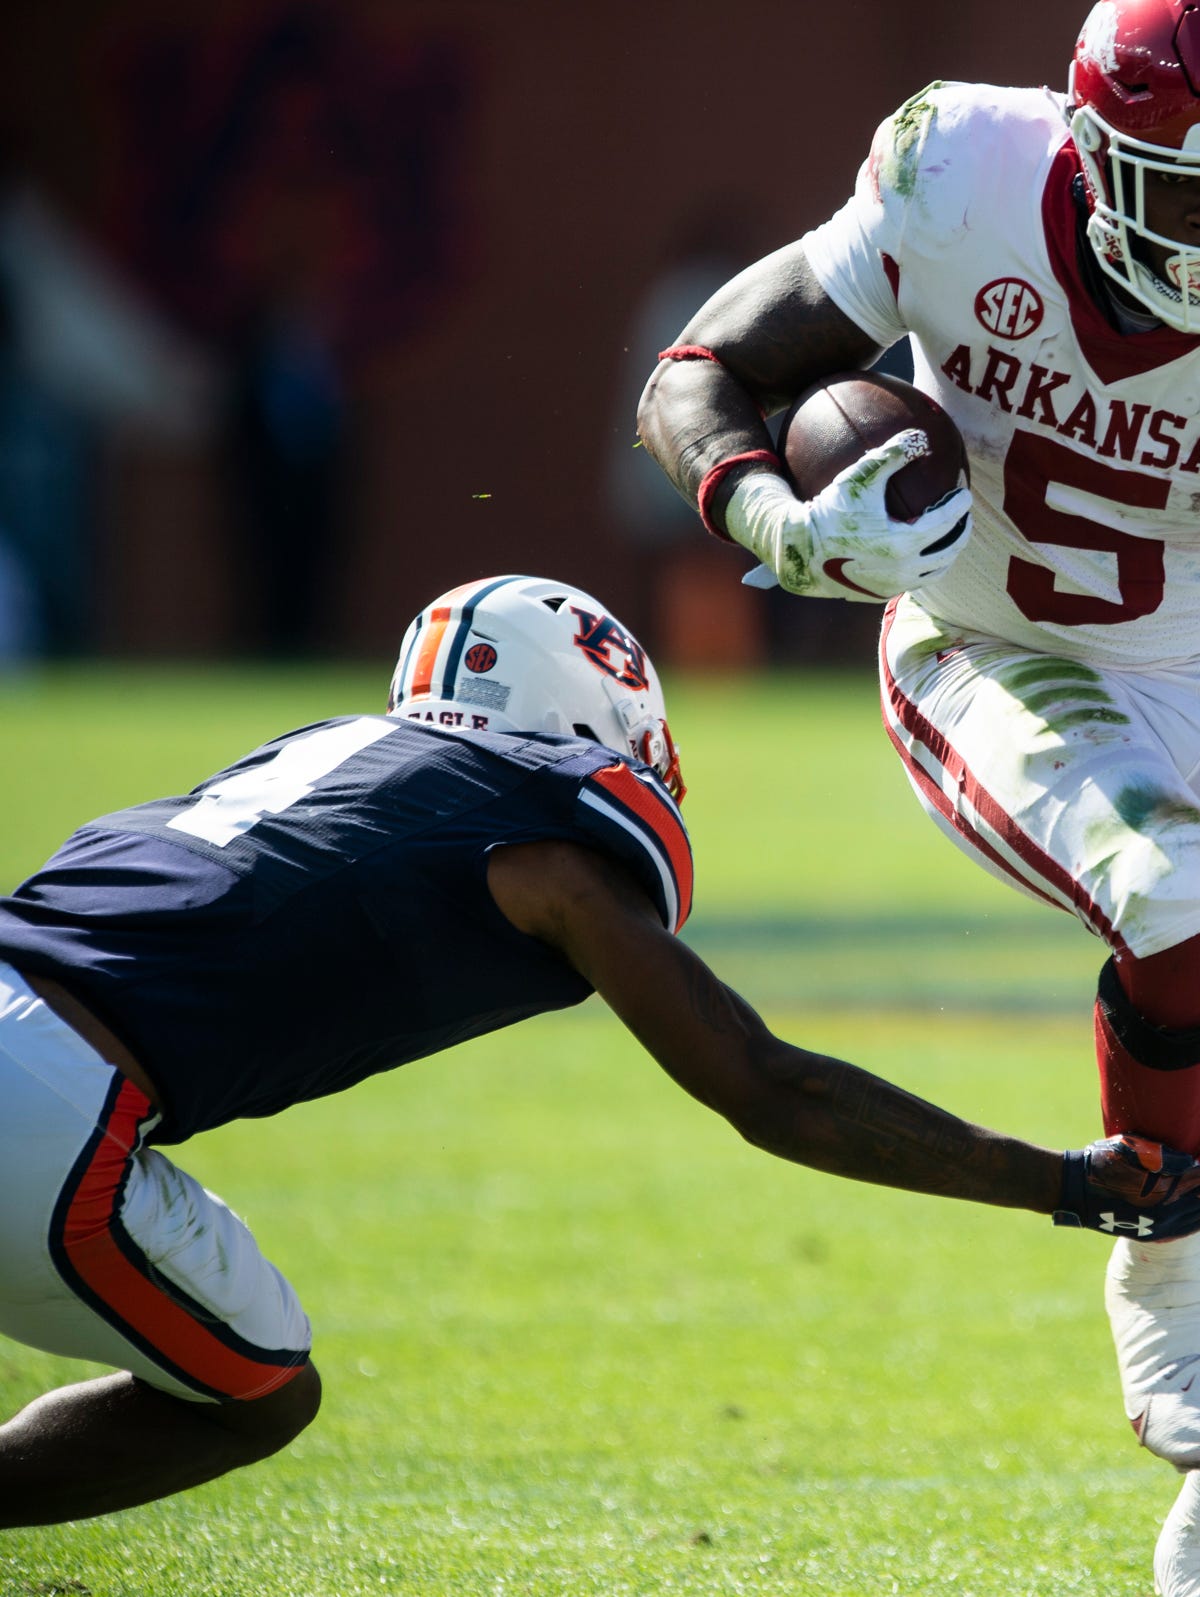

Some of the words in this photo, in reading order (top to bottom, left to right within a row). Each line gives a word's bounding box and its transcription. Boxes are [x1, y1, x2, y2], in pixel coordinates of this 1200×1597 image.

[979, 281, 1040, 337] SEC
[1002, 428, 1172, 627] 5
[467, 644, 497, 673] SEC
